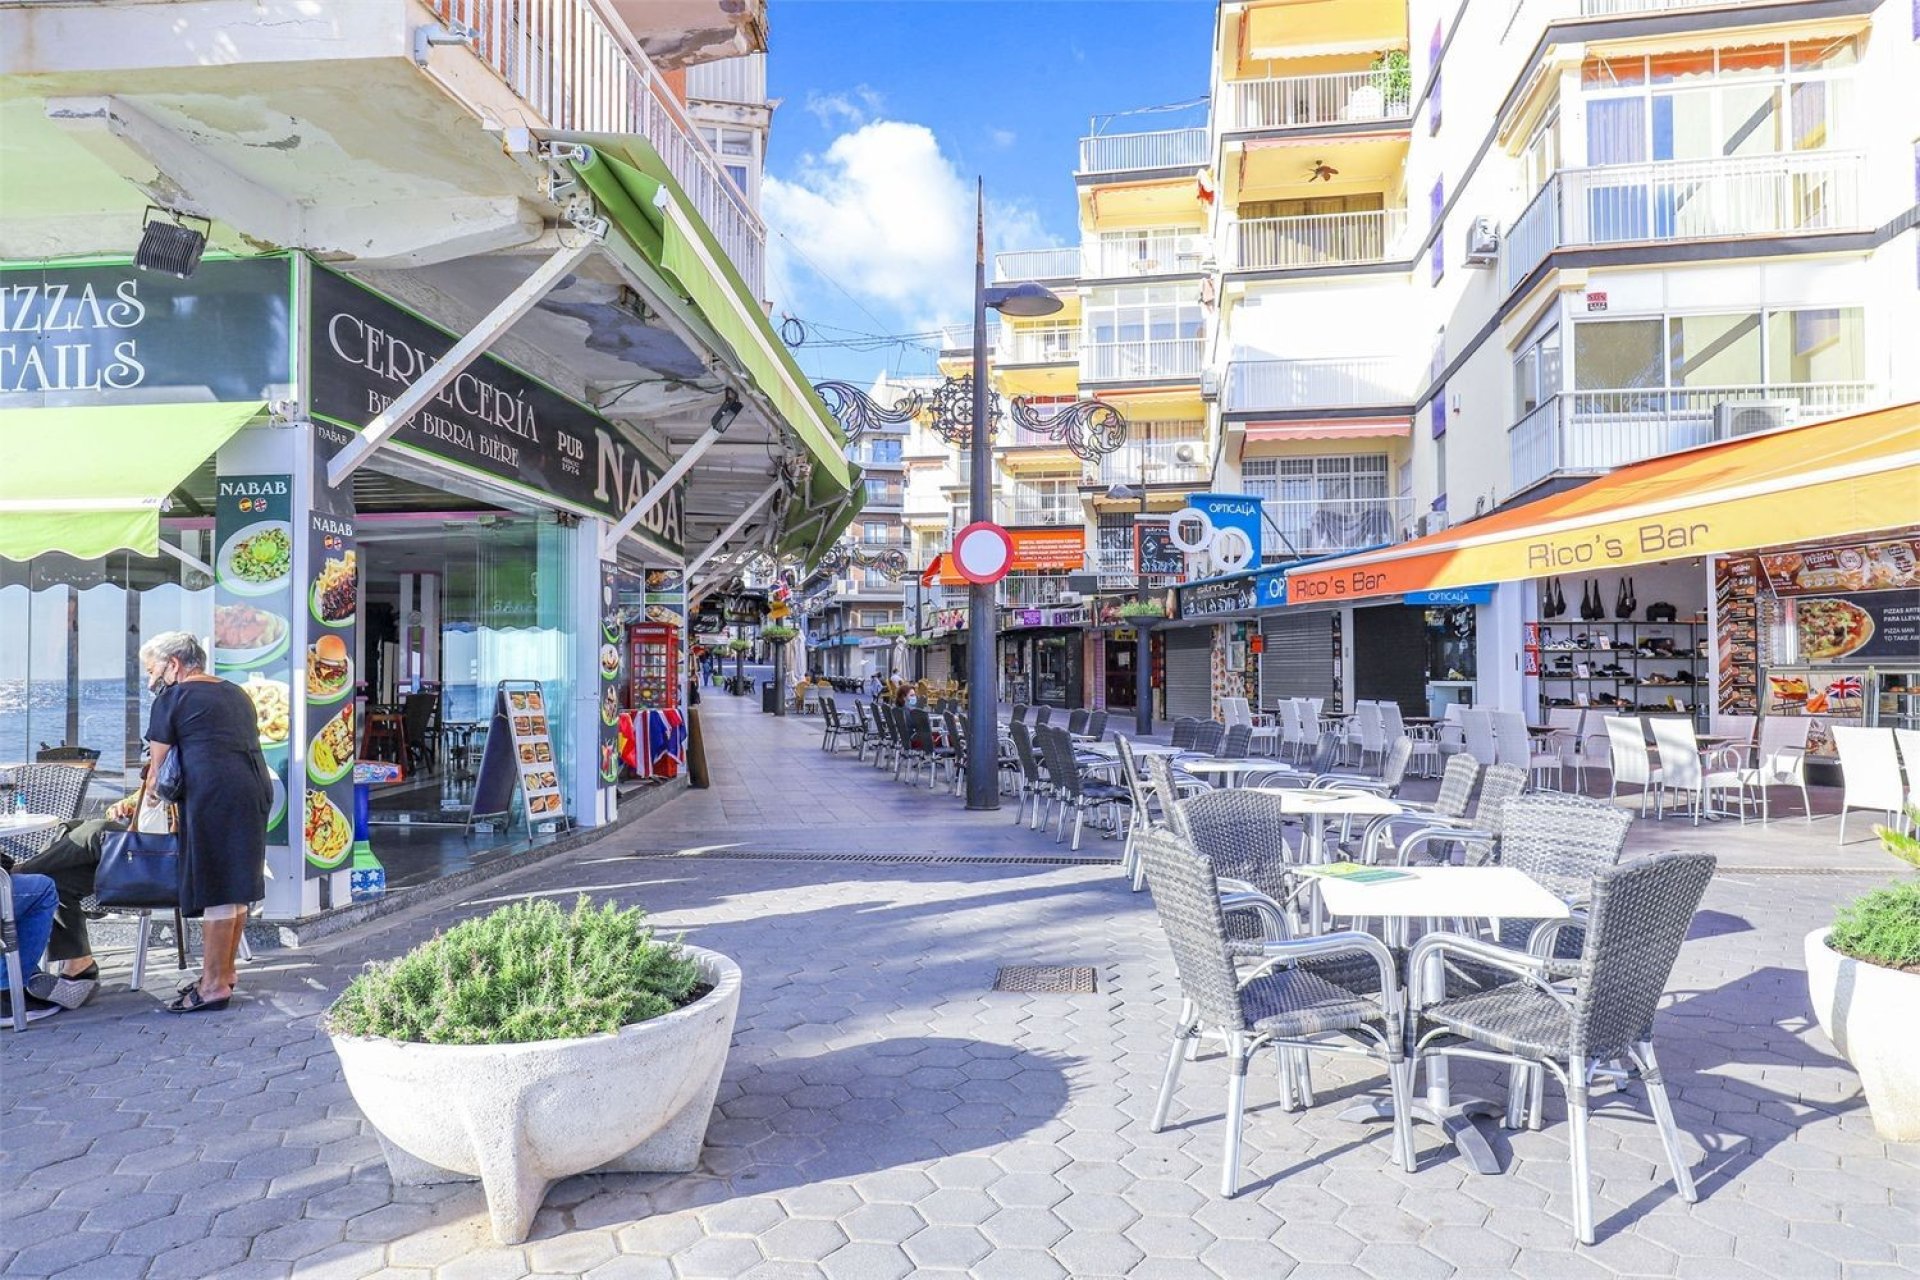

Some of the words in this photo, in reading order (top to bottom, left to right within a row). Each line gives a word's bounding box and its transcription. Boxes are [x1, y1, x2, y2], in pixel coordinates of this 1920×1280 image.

[423, 410, 475, 452] BIRRA
[557, 429, 585, 461] PUB
[219, 481, 288, 497] NABAB
[312, 516, 353, 538] NABAB
[1527, 534, 1624, 570] Rico's
[1638, 523, 1710, 554] Bar
[1295, 575, 1346, 599] Rico's
[1352, 571, 1387, 592] Bar
